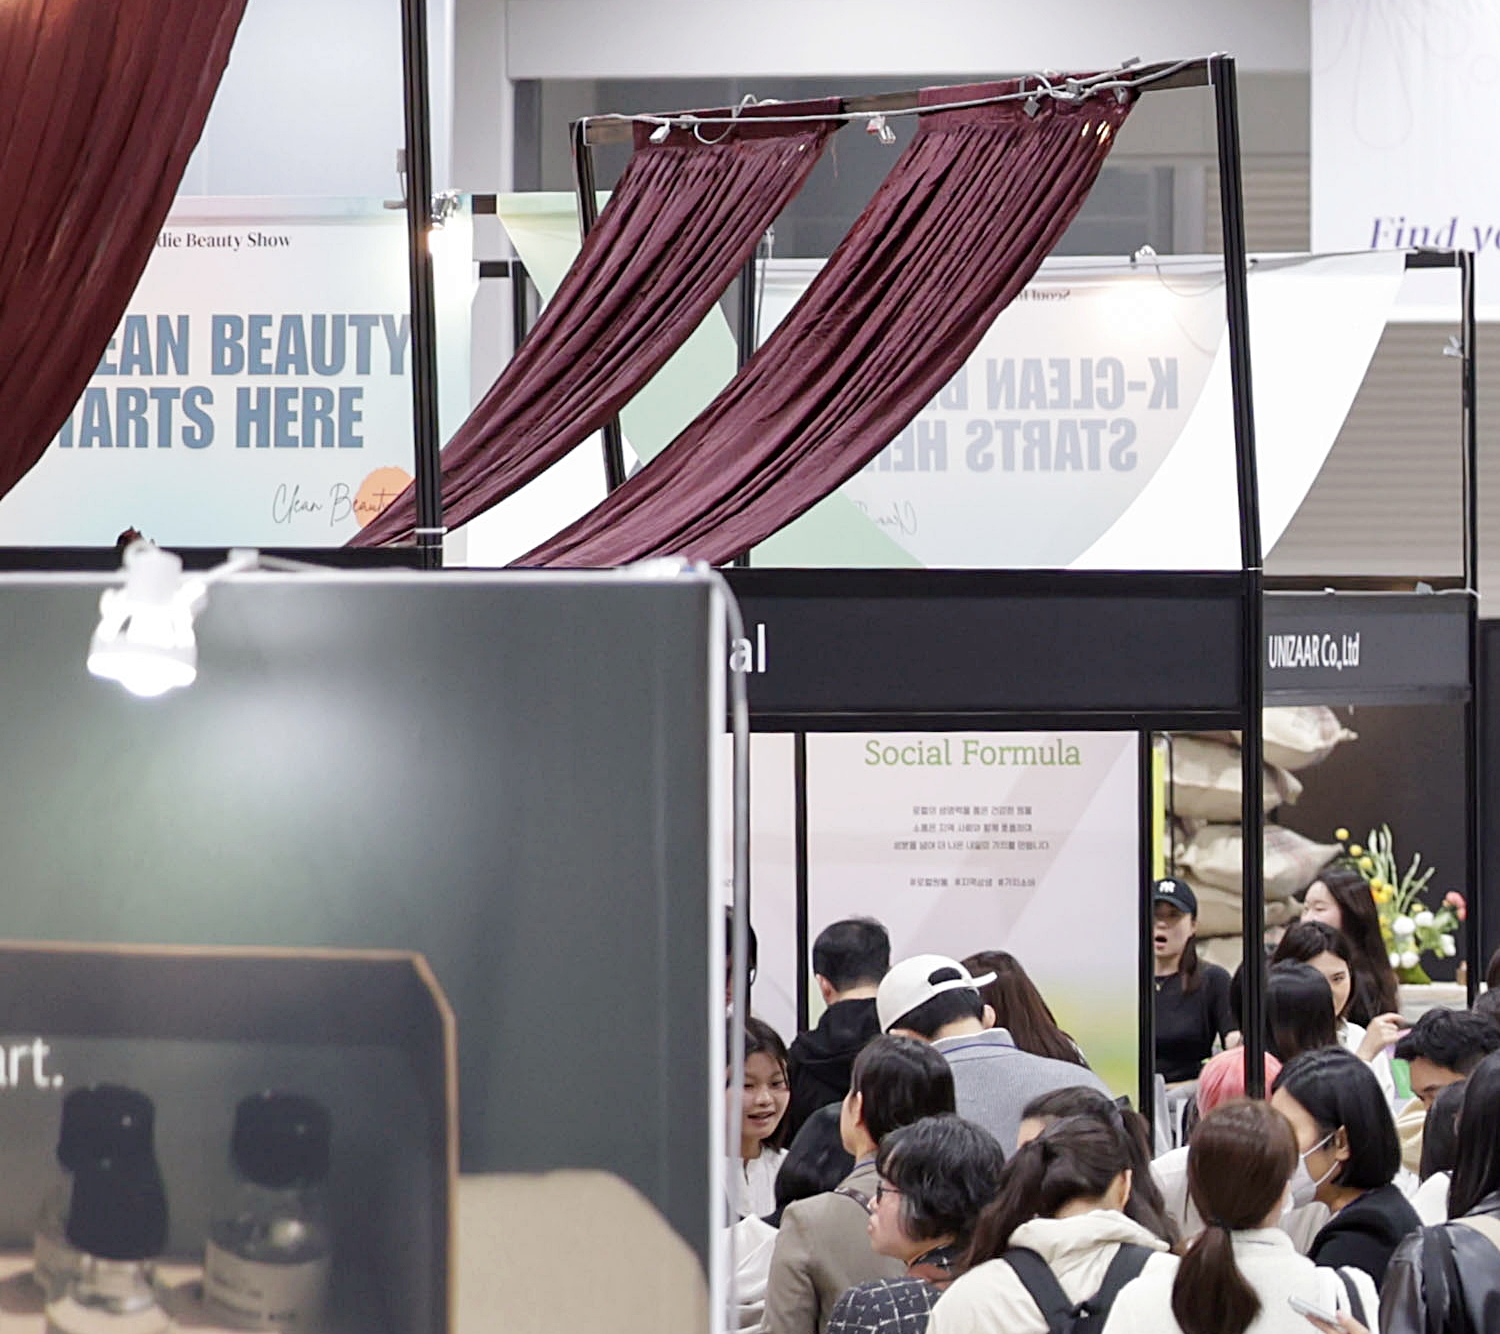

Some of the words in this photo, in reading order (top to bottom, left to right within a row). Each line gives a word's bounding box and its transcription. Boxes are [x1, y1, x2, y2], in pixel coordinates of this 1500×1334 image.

[157, 232, 182, 248] die
[186, 232, 242, 252] Beauty
[246, 231, 291, 248] Show
[1369, 216, 1458, 250] Find
[210, 314, 410, 376] BEAUTY
[234, 386, 365, 449] HERE
[1268, 634, 1319, 669] UNIZAAR
[864, 738, 952, 766] Social
[961, 738, 1081, 766] Formula
